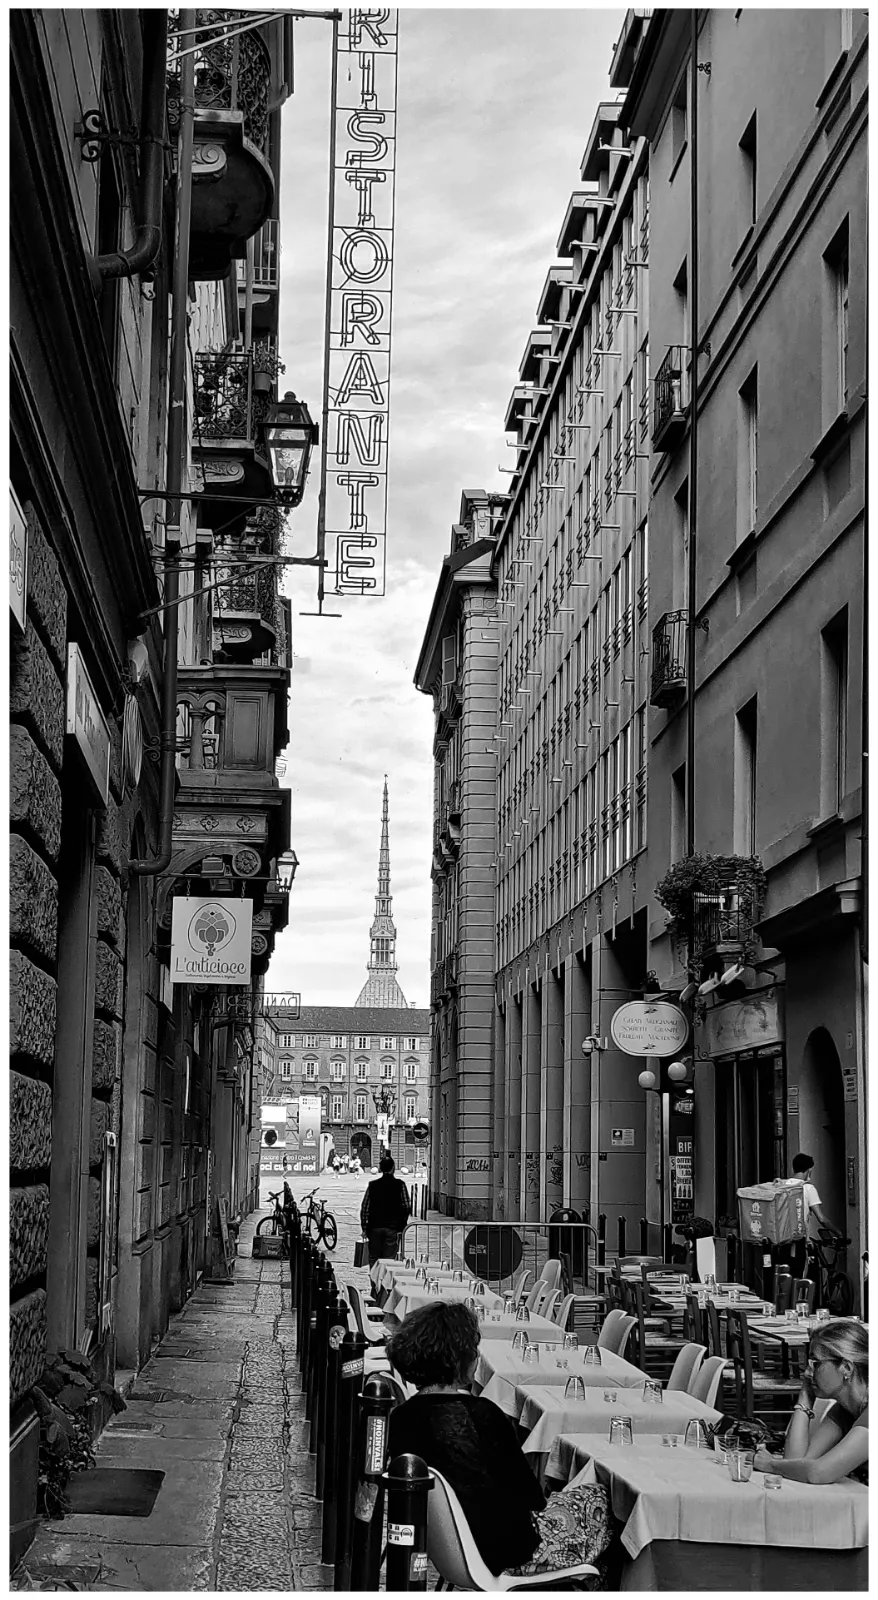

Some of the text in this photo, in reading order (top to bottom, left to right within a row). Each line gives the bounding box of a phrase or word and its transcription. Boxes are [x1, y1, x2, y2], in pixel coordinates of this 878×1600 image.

[335, 8, 390, 590] RISTORANTE
[274, 1162, 292, 1171] cua
[293, 1161, 302, 1171] di
[303, 1161, 316, 1171] noi
